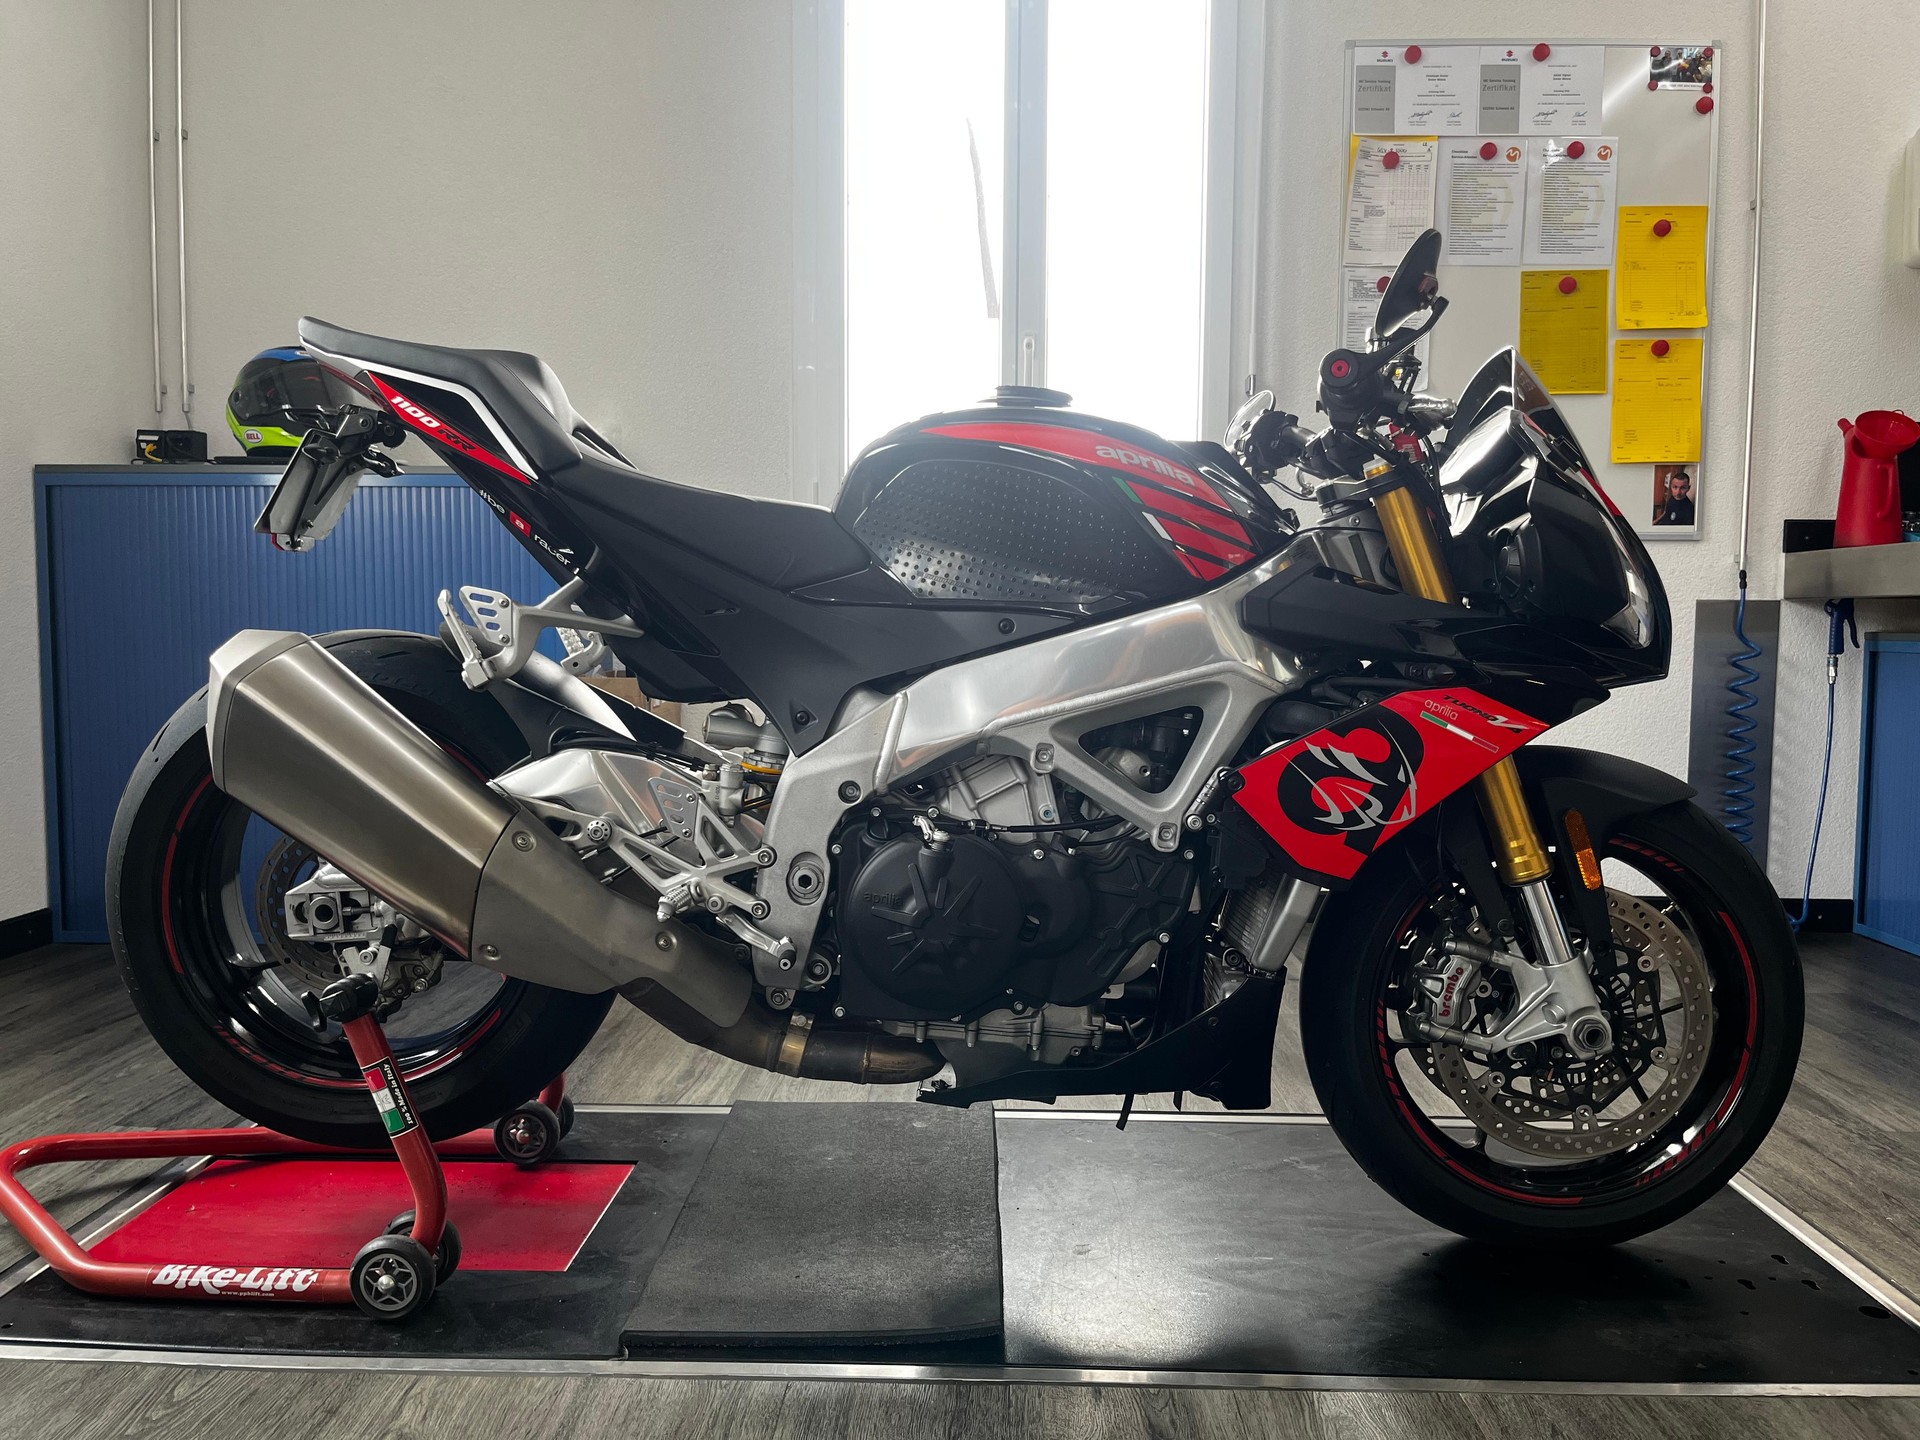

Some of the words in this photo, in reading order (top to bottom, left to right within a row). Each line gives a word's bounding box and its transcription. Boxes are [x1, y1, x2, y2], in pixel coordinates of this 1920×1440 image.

[1358, 85, 1391, 93] Zertifikat
[1482, 84, 1516, 92] Zertifikat
[391, 396, 441, 428] 1100
[246, 432, 260, 440] BELL
[1096, 445, 1195, 487] aprilia
[480, 489, 505, 514] #be
[534, 534, 571, 565] racer
[1424, 699, 1458, 721] aprilia
[1439, 967, 1464, 1017] brembo
[383, 1063, 394, 1080] Italy
[391, 1080, 398, 1088] in
[395, 1088, 405, 1106] Made
[404, 1112, 414, 1124] 100
